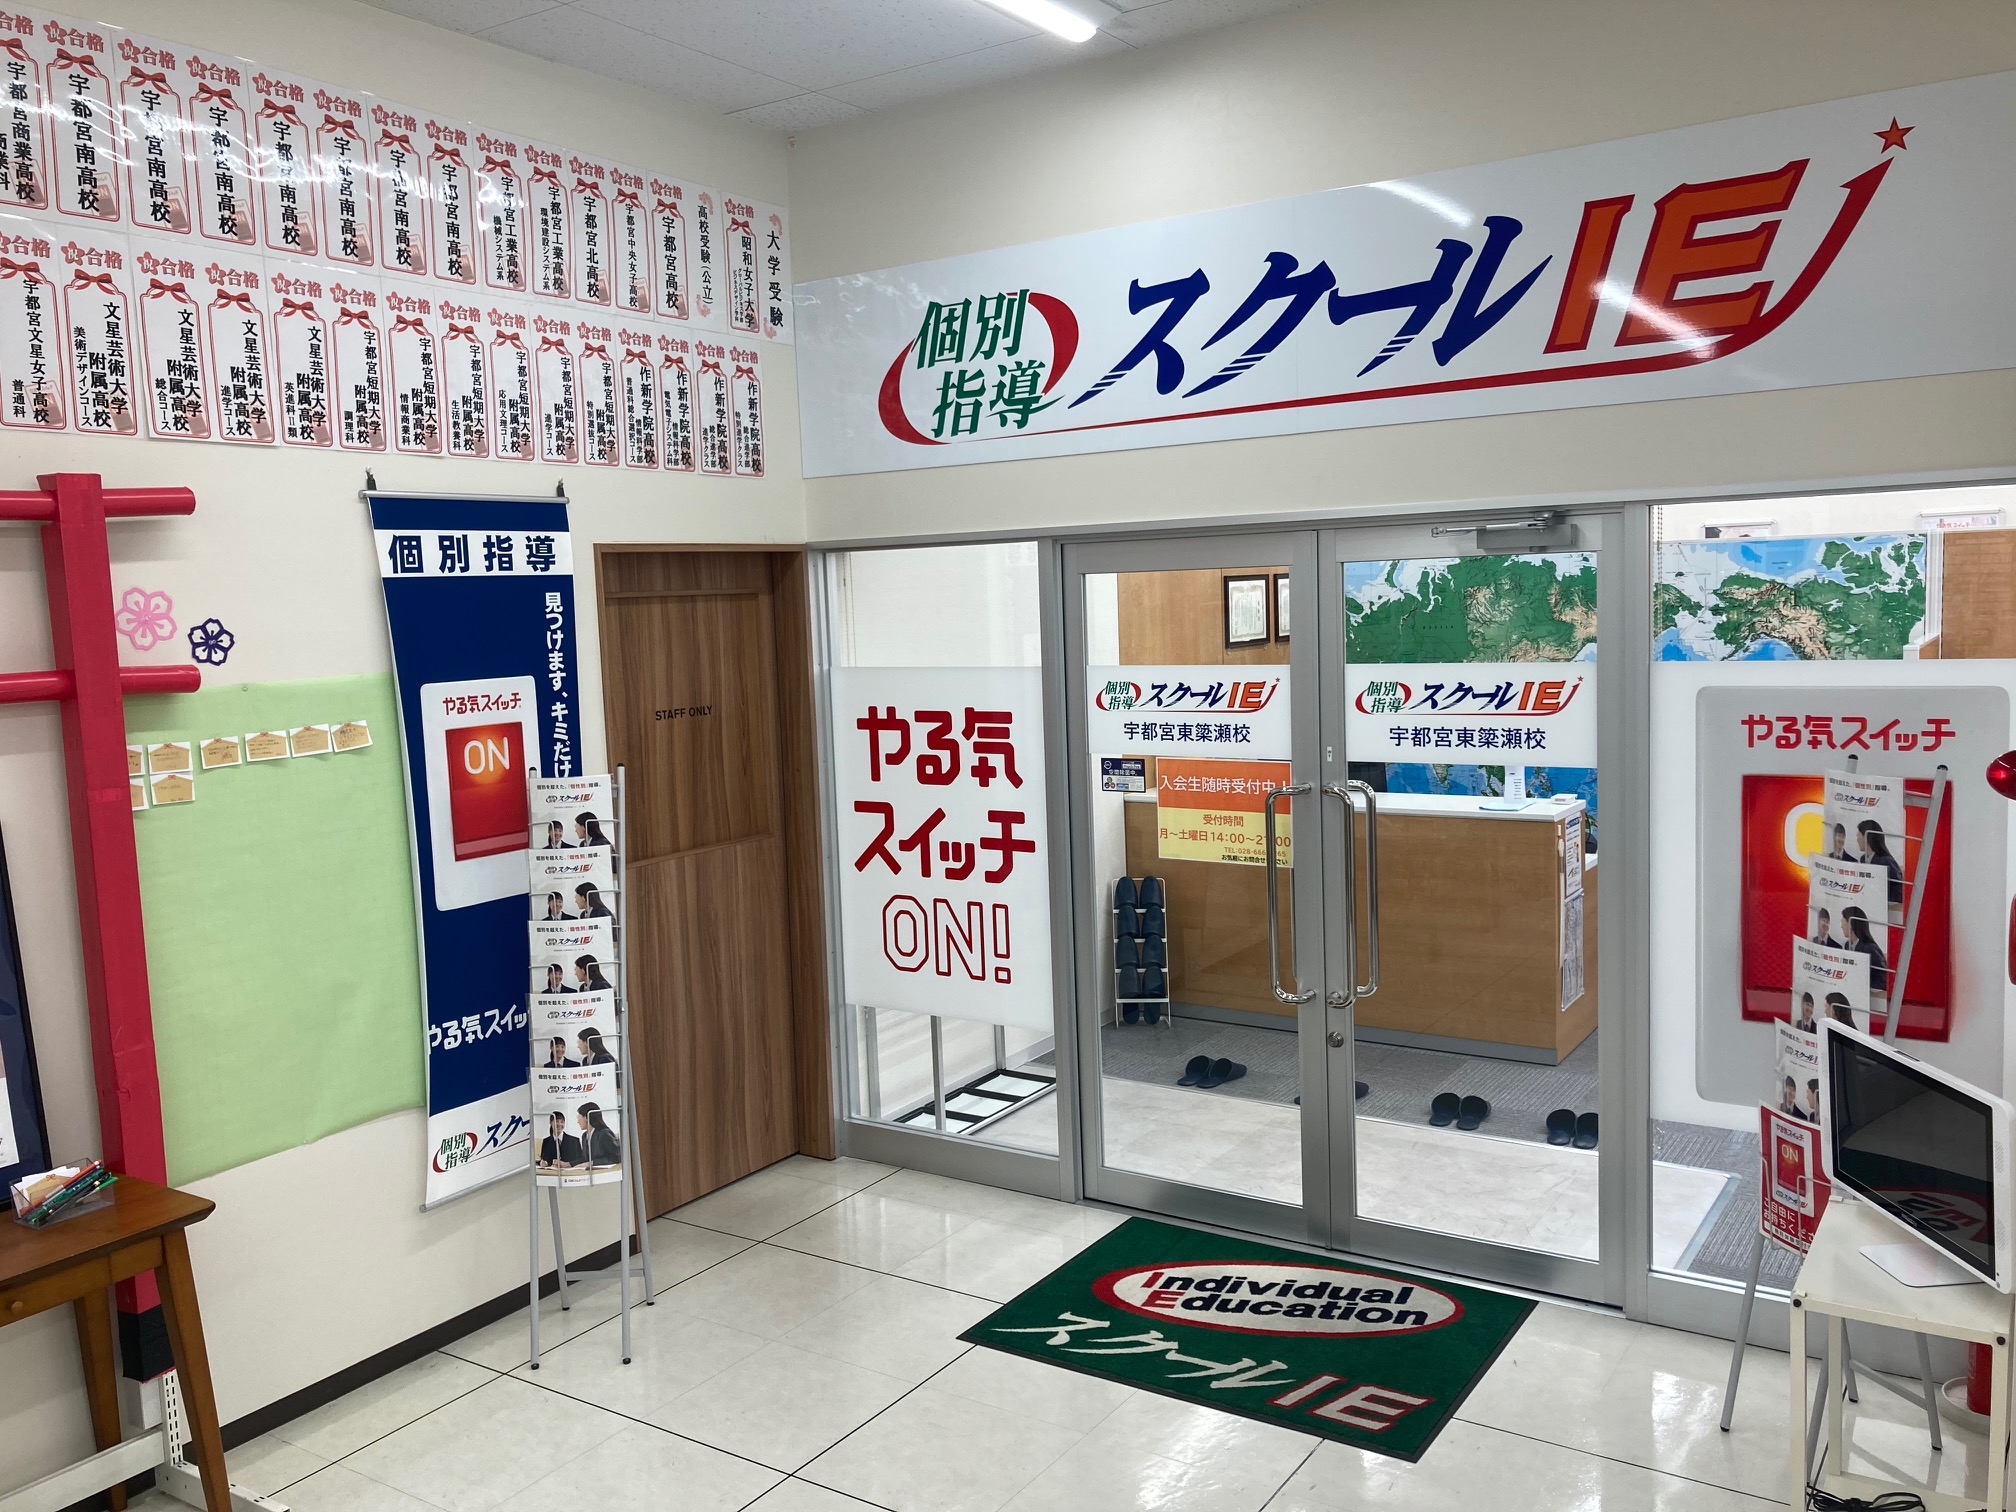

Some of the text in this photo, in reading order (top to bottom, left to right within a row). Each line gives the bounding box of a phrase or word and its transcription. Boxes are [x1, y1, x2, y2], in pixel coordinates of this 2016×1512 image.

[69, 74, 99, 212] 宇都宮南高校
[141, 90, 171, 223] 宇宮南高校
[548, 187, 564, 291] 宇都宮工業高校
[584, 196, 599, 299] 宇都宮北高校
[625, 204, 637, 308] 宇都宮中央女子高校
[662, 216, 679, 310] 宇都宮高校
[741, 236, 754, 328] 昭和女子大学
[767, 231, 784, 327] 大学受験
[23, 279, 50, 424] 宇都宮文星女子高校
[103, 302, 128, 415] 文星芸術大学
[178, 309, 203, 417] 文星芸術大学
[911, 288, 1030, 371] 個別
[12, 379, 26, 418] 普通科
[74, 326, 92, 427] 美術デザインコース
[89, 352, 112, 428] 附属高校
[155, 378, 171, 431] 総合コース
[167, 359, 189, 432] 附属高校
[230, 366, 252, 436] 附属高校
[242, 319, 266, 424] 文星芸術大学
[308, 326, 326, 427] 文星芸術大学
[364, 331, 381, 435] 宇都宮短期大学
[419, 337, 437, 438] 宇都宮短期大学
[469, 345, 485, 443] 宇都宮短期大学
[516, 351, 531, 447] 宇都宮短期大学
[560, 357, 575, 449] 宇都宮短期大学
[932, 358, 1066, 438] 指導
[221, 385, 235, 436] 進学コース
[297, 373, 314, 441] 附属高校
[344, 410, 354, 443] 調理科
[355, 384, 370, 444] 附属高校
[400, 393, 411, 446] 情報商業科
[411, 388, 426, 446] 附属高校
[452, 400, 461, 451] 生活教養科
[462, 395, 474, 451] 附属高校
[499, 389, 508, 453] 応用文理コース
[509, 399, 521, 454] 附属高校
[544, 413, 554, 456] 進学コース
[554, 403, 566, 456] 附属高校
[596, 409, 607, 461] 附属高校
[602, 362, 616, 452] 宇都宮短期大学
[640, 367, 655, 464] 作新学院高校
[677, 371, 692, 466] 作新学院高校
[714, 377, 728, 470] 作新学院高校
[747, 382, 761, 472] 作新学院高校
[388, 533, 556, 574] 個別指導
[442, 692, 522, 715] やる気スイッチ
[655, 705, 713, 721] STAFF ONLY
[1105, 681, 1131, 695] 個別
[1109, 695, 1137, 710] 指導
[1367, 681, 1400, 696] 個別
[1370, 697, 1403, 713] 指導
[464, 736, 510, 775] ON
[856, 705, 1024, 789] やる気
[1123, 722, 1251, 743] 宇都宮東簗瀬校
[1389, 726, 1546, 749] 宇都宮東簗瀬校
[1741, 714, 1956, 751] やる気スイッチ
[853, 800, 1036, 884] スイッチ
[1203, 814, 1244, 827] 受付時間
[882, 894, 1012, 984] ON!
[440, 1132, 467, 1155] 個別
[445, 1146, 472, 1170] 指導
[1782, 1144, 1799, 1163] ON
[1138, 1289, 1429, 1326] Education
[1140, 1271, 1414, 1305] Individual
